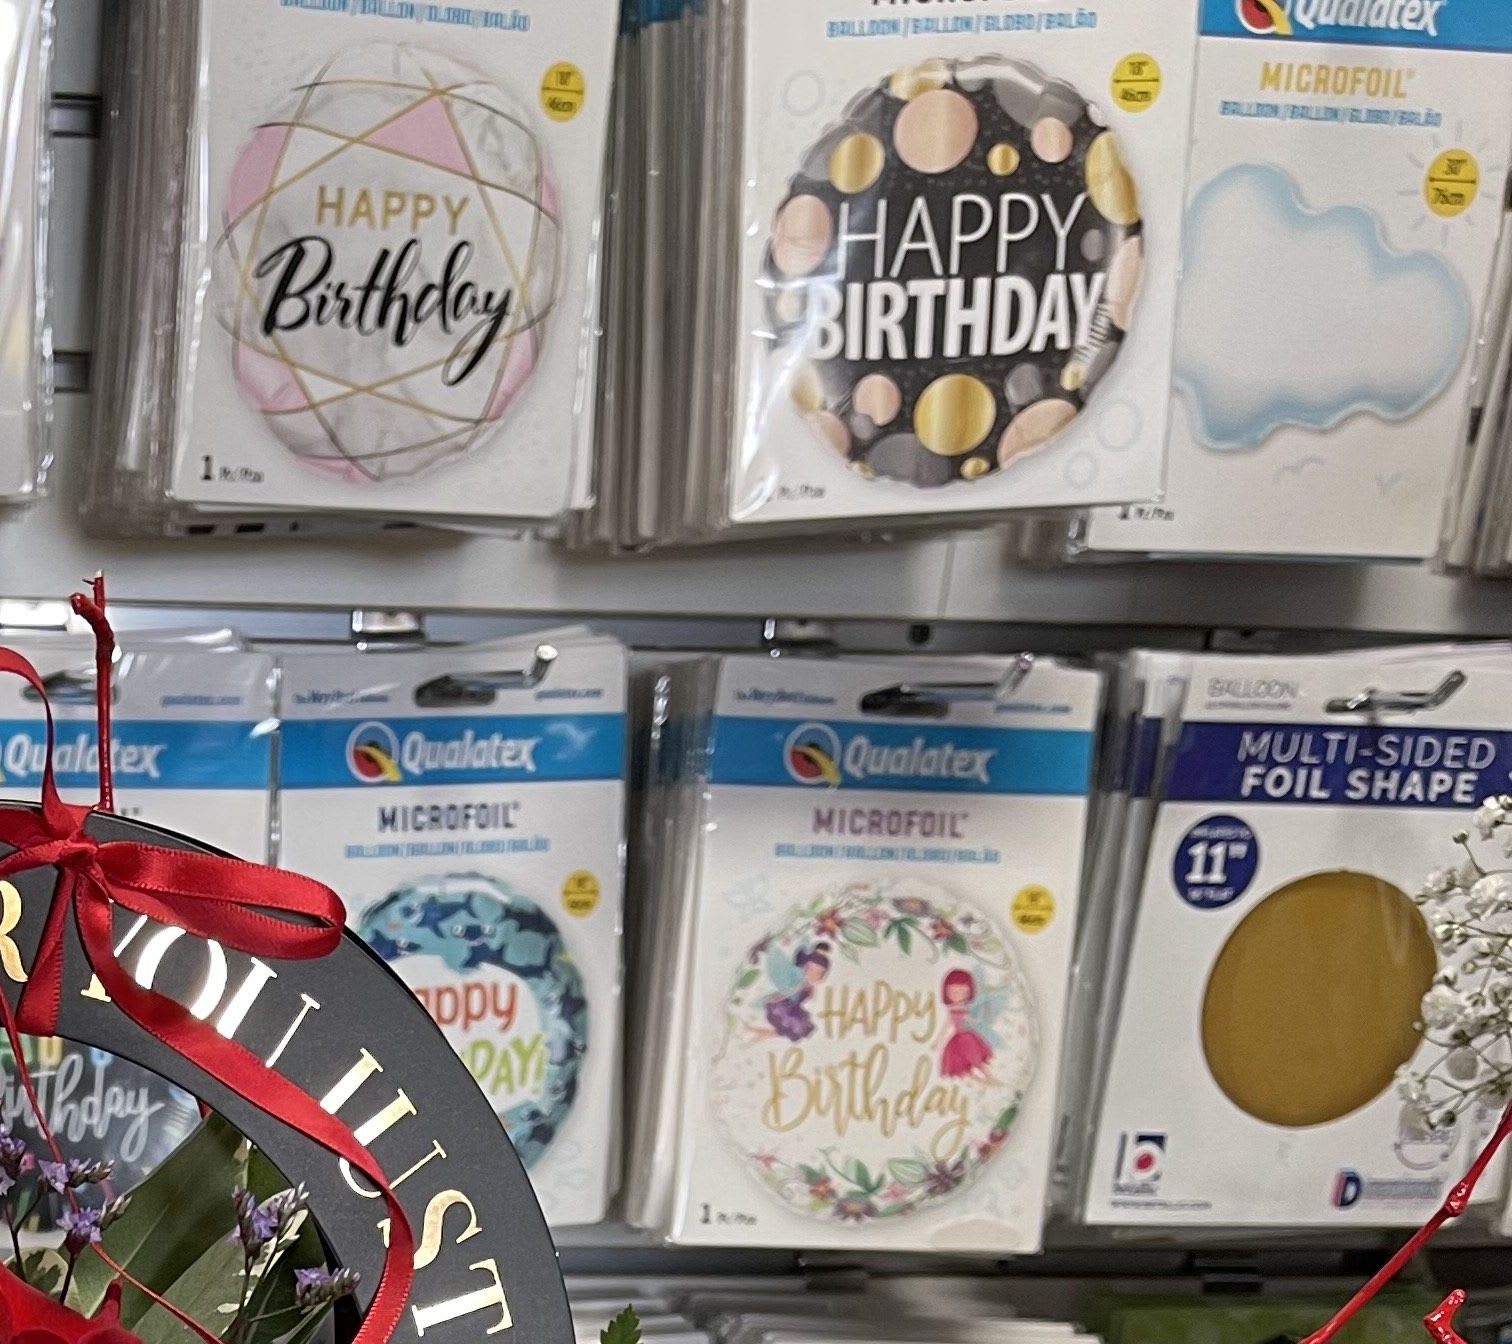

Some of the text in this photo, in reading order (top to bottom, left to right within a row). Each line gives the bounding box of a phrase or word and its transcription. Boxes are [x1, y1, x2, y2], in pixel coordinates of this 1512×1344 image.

[316, 186, 470, 232] HAPPY
[836, 192, 1088, 280] HAPPY
[253, 235, 513, 386] Birthday
[810, 272, 1106, 361] BIRTHDAY
[400, 730, 542, 774] Qualatex
[843, 738, 996, 784] Qualatex
[1237, 730, 1497, 770] MULTI-SIDED
[1240, 765, 1480, 803] FOIL SHAPE
[761, 1042, 971, 1162] Birthday
